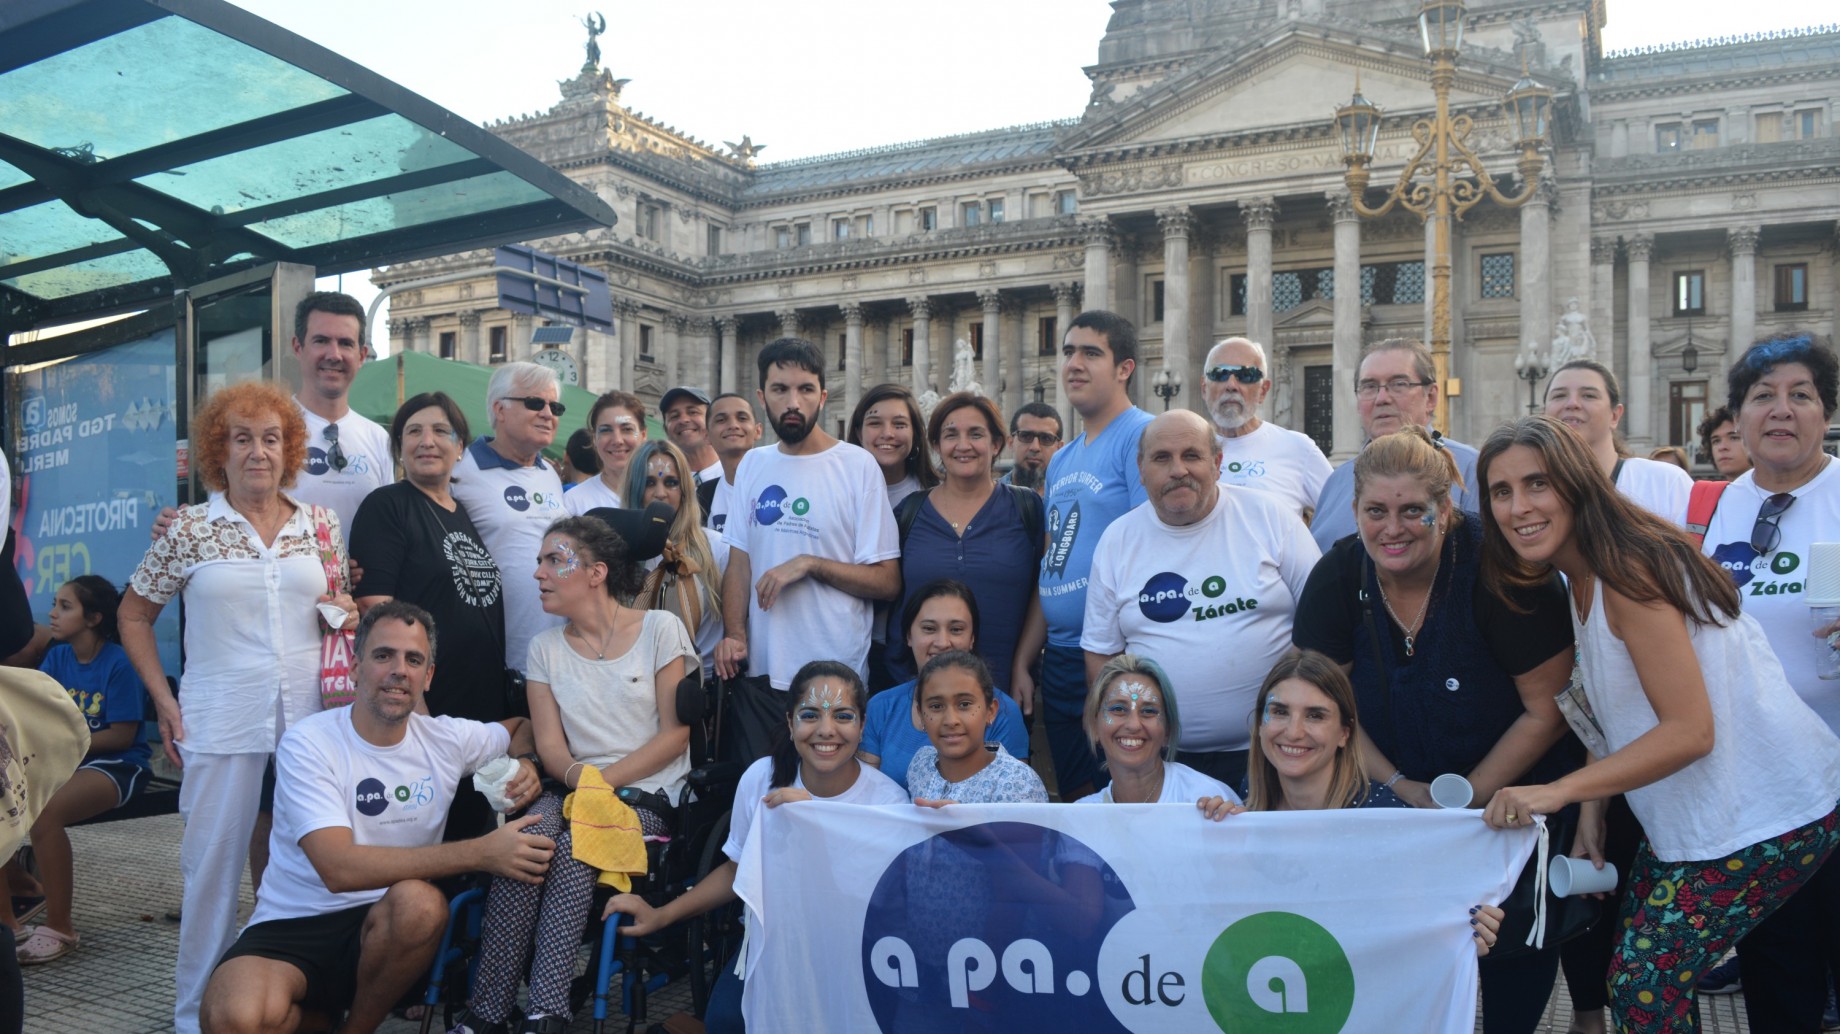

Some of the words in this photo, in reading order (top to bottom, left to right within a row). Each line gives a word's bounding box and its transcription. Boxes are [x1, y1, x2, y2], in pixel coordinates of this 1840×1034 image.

[1200, 157, 1301, 180] CONGRESO
[1313, 144, 1407, 168] NANAL
[548, 351, 559, 362] 12
[570, 371, 578, 382] 3
[1078, 471, 1104, 494] SURFER
[1054, 511, 1079, 567] LONGBOARD
[1755, 561, 1769, 570] de
[1052, 577, 1089, 596] SUMMER
[1139, 587, 1184, 604] a.pa.
[1187, 586, 1200, 597] de
[1750, 578, 1807, 596] Zára
[1192, 596, 1259, 622] Zárate
[357, 792, 383, 804] a.pa.
[409, 776, 434, 806] 25
[1121, 953, 1186, 1007] de
[1246, 955, 1309, 1014] a
